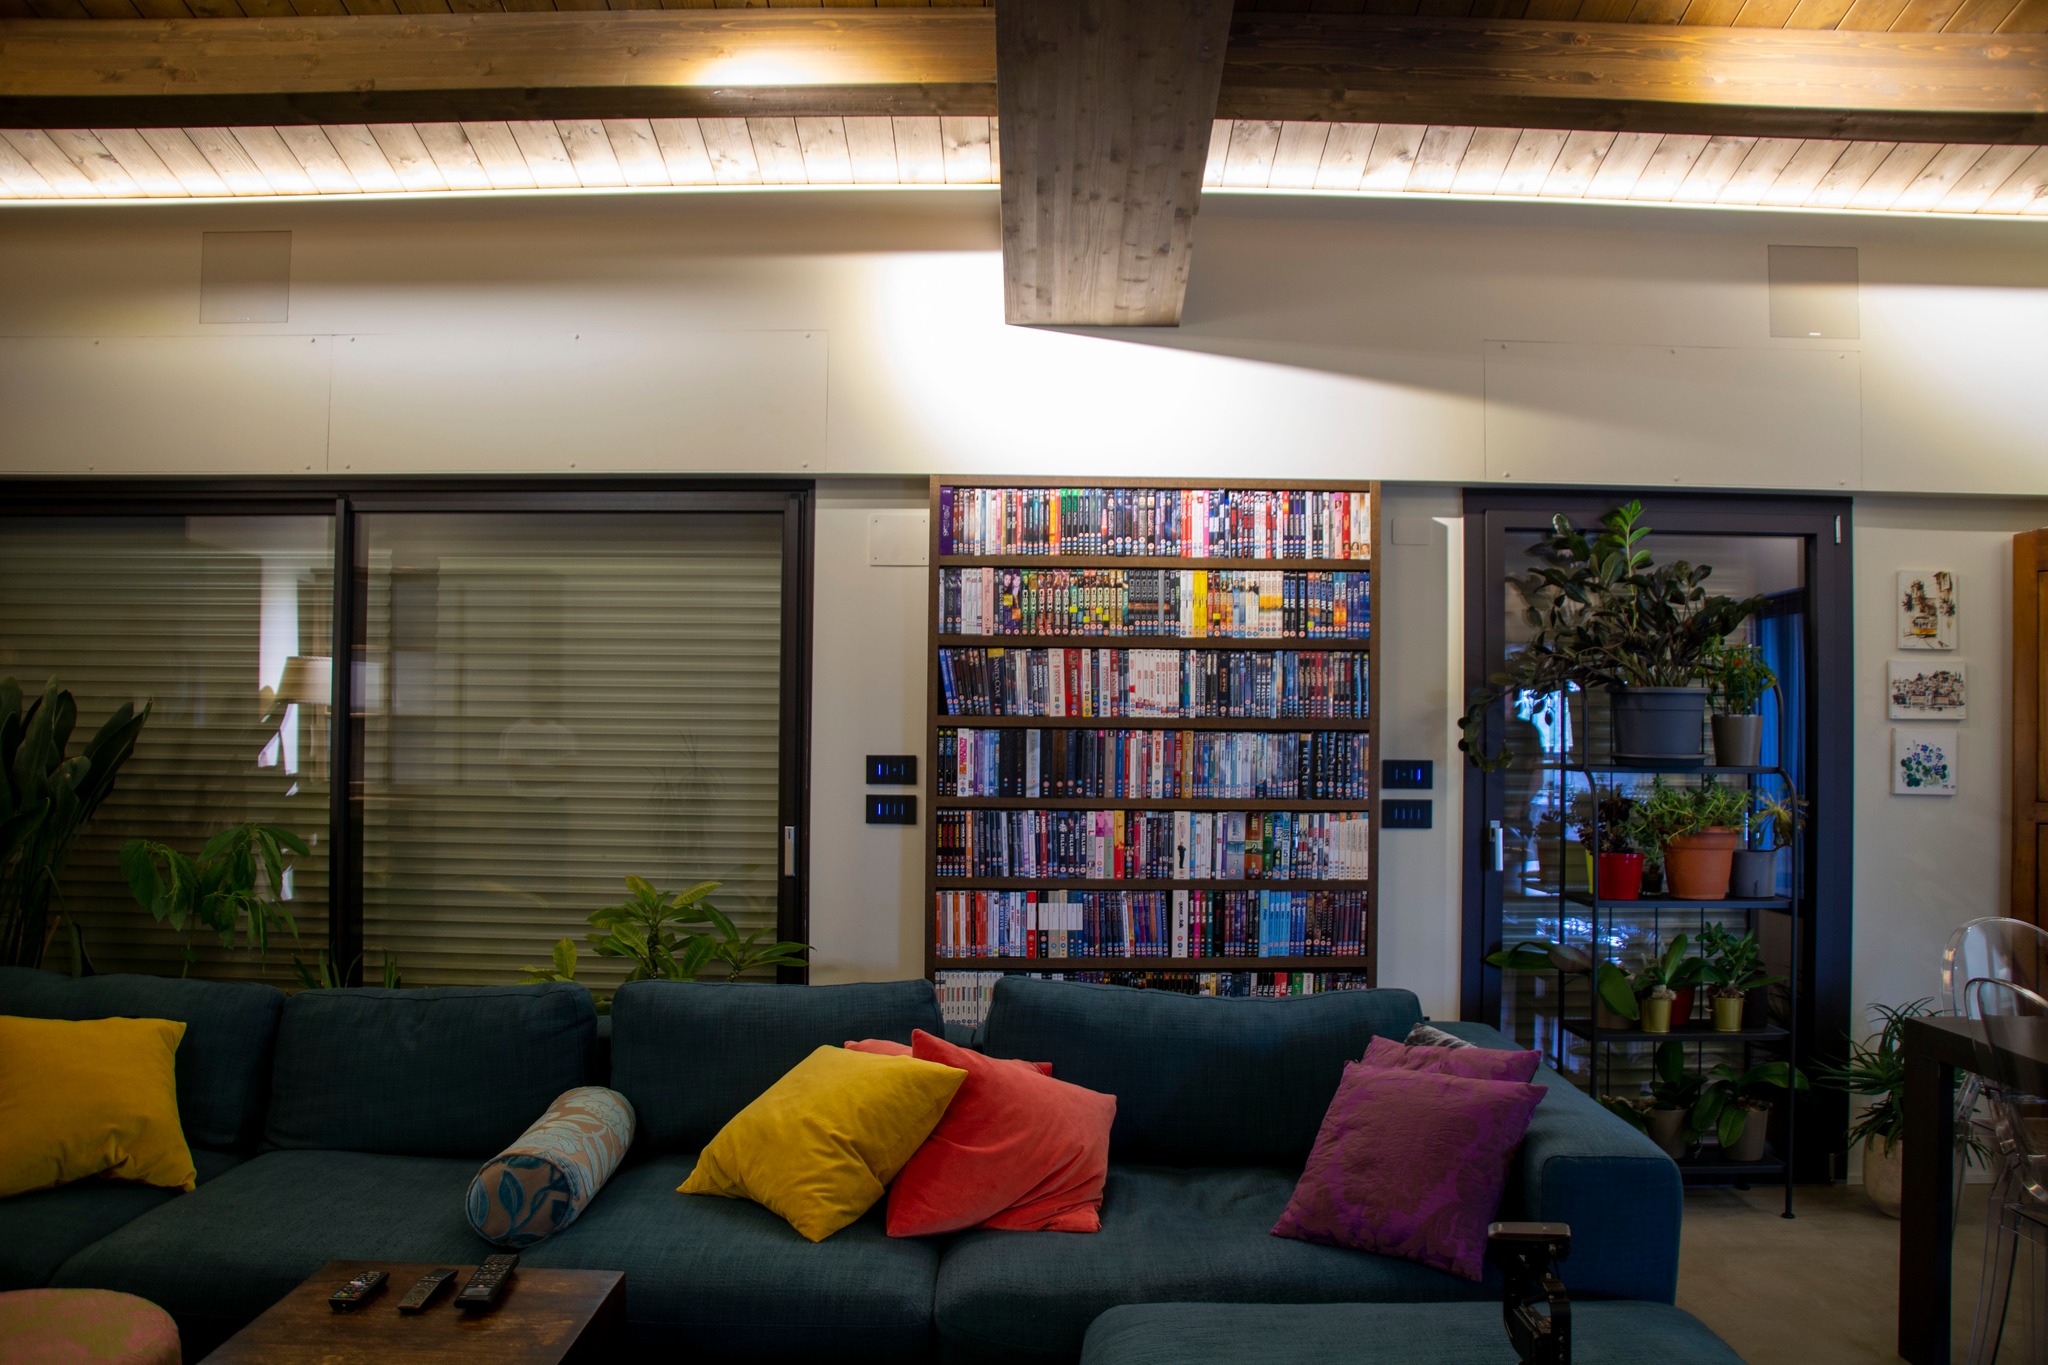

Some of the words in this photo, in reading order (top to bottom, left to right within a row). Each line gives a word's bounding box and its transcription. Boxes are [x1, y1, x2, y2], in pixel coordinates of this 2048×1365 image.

[1284, 598, 1289, 608] NY
[1290, 598, 1296, 608] NY
[1299, 598, 1305, 608] NY
[1308, 599, 1314, 608] NY
[1315, 599, 1320, 608] NY
[1321, 600, 1326, 610] NY
[1328, 601, 1333, 611] NY
[1252, 844, 1258, 853] 2
[1292, 849, 1296, 858] 6
